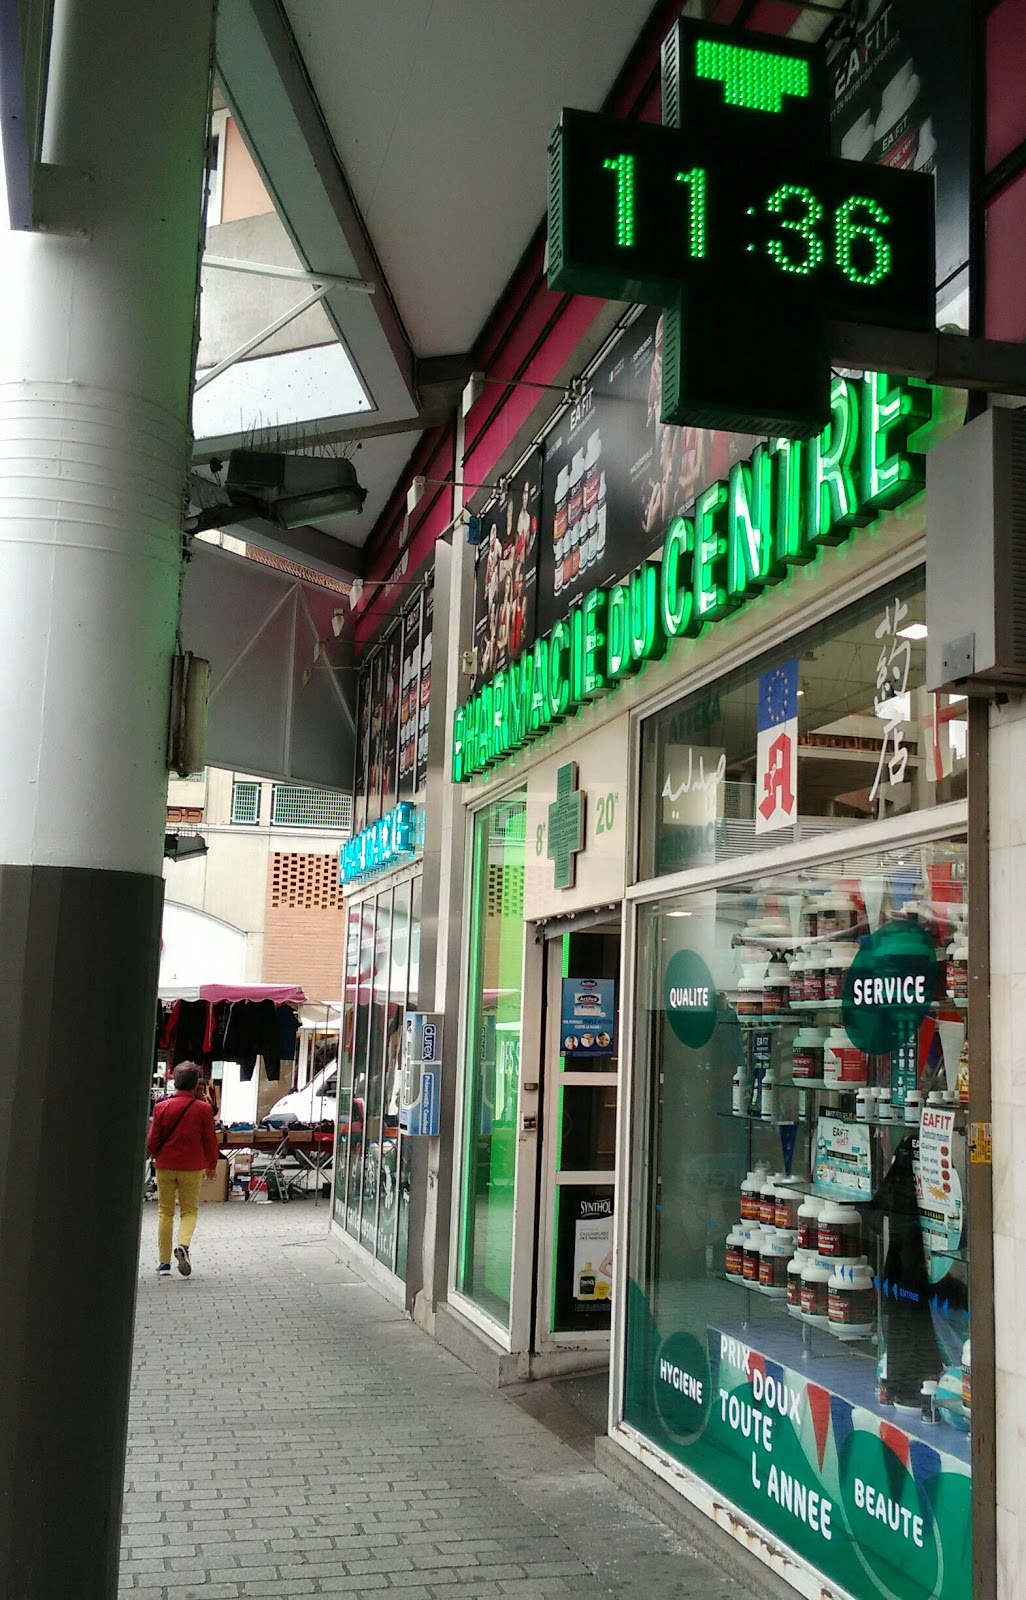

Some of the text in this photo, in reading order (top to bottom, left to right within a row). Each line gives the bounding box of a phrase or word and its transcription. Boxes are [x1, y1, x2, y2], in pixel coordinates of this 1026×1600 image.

[603, 154, 891, 285] 11:36
[451, 369, 931, 784] PHARMACIE DU CENTRE
[670, 988, 708, 1008] QUALITE
[854, 975, 926, 1006] SERVICE
[424, 1026, 434, 1059] durex
[922, 1112, 952, 1131] EAFIT
[580, 1200, 613, 1215] SYNTHOL
[720, 1335, 751, 1375] PRIX
[660, 1358, 703, 1405] HYGIENE
[753, 1368, 801, 1425] DOUX
[719, 1388, 773, 1452] TOUTE
[751, 1450, 832, 1541] L ANNEE
[854, 1477, 924, 1548] BEAUTE
